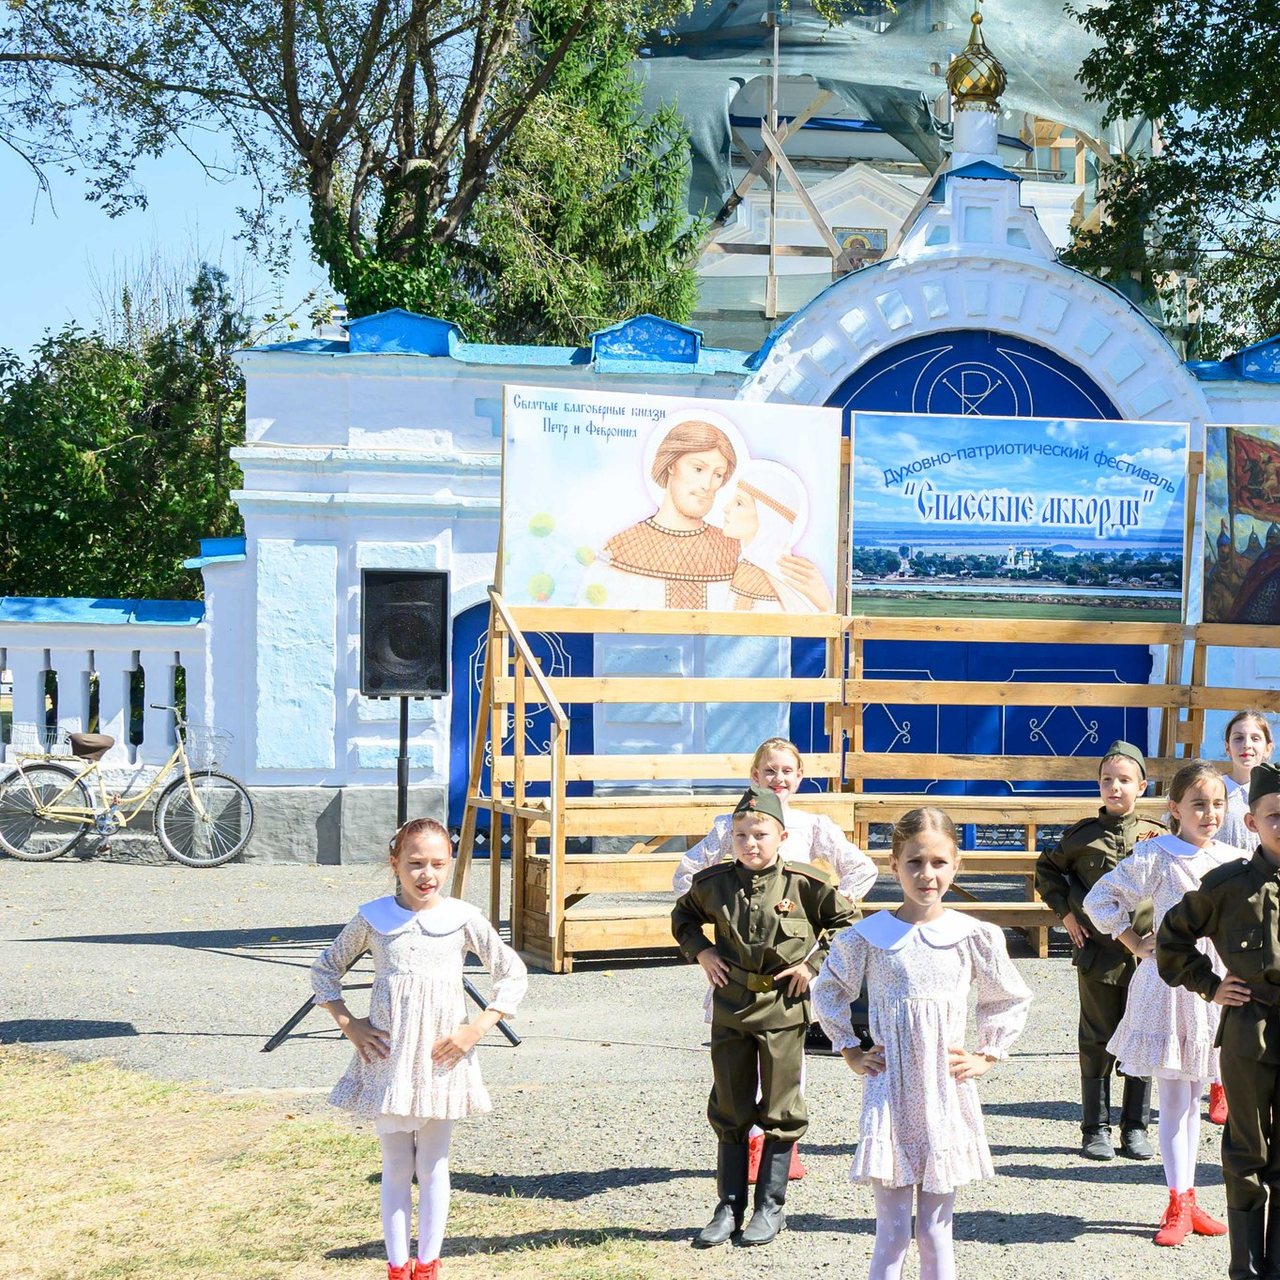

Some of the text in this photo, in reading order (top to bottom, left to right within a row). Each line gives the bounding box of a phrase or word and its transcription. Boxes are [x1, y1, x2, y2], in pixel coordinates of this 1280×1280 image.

[543, 417, 569, 441] Петр
[573, 425, 581, 435] и
[564, 402, 626, 421] благоверные
[883, 443, 1176, 494] Духовно-патриотический фестиваль
[904, 480, 1154, 536] "Спасские аккорды"
